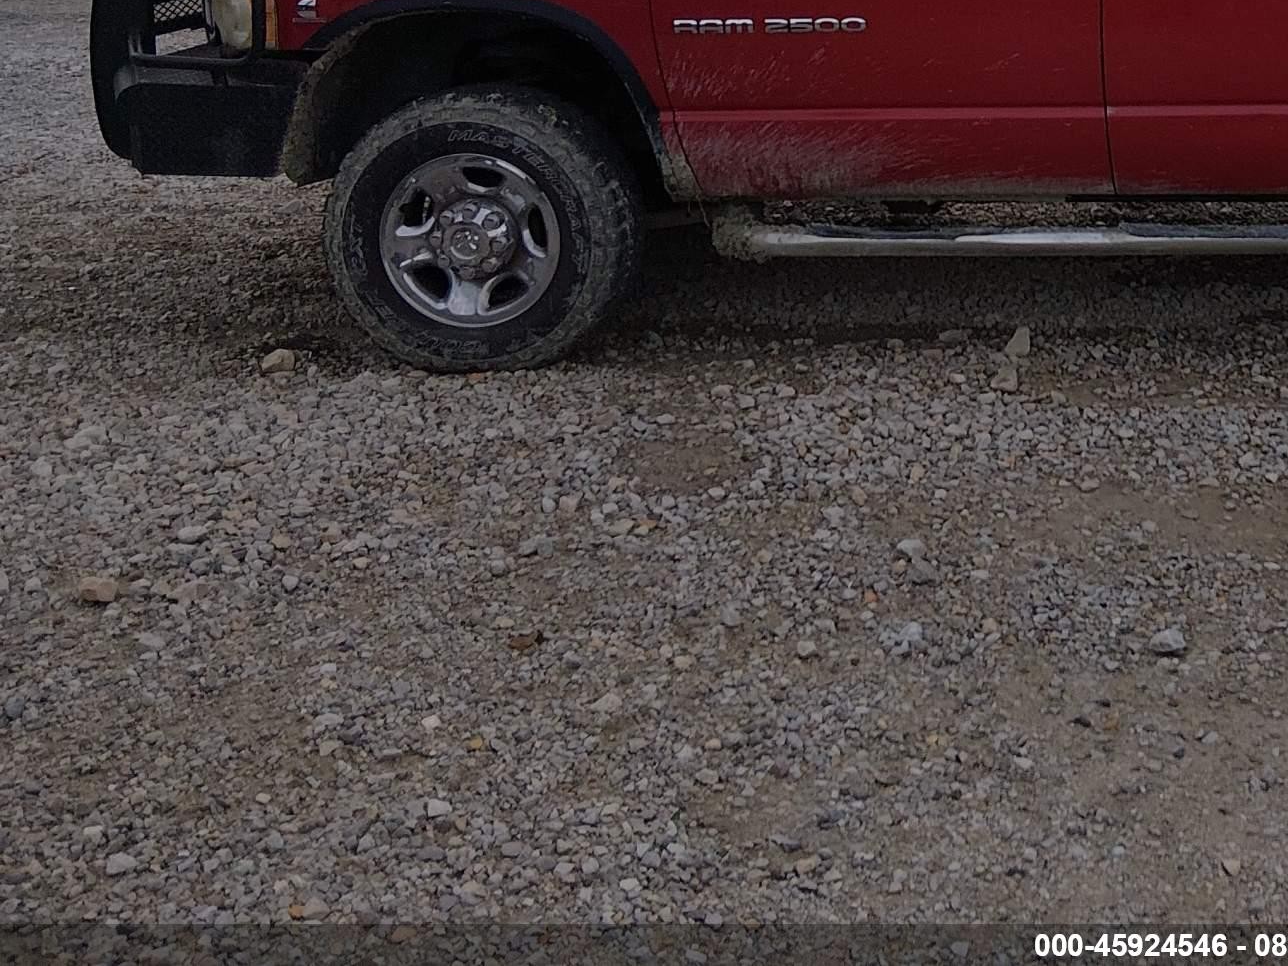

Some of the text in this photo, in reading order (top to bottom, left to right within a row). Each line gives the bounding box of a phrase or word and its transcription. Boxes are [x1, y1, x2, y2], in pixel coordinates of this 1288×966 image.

[672, 17, 867, 34] RAM 2500
[447, 129, 587, 274] MASTERCRAFT
